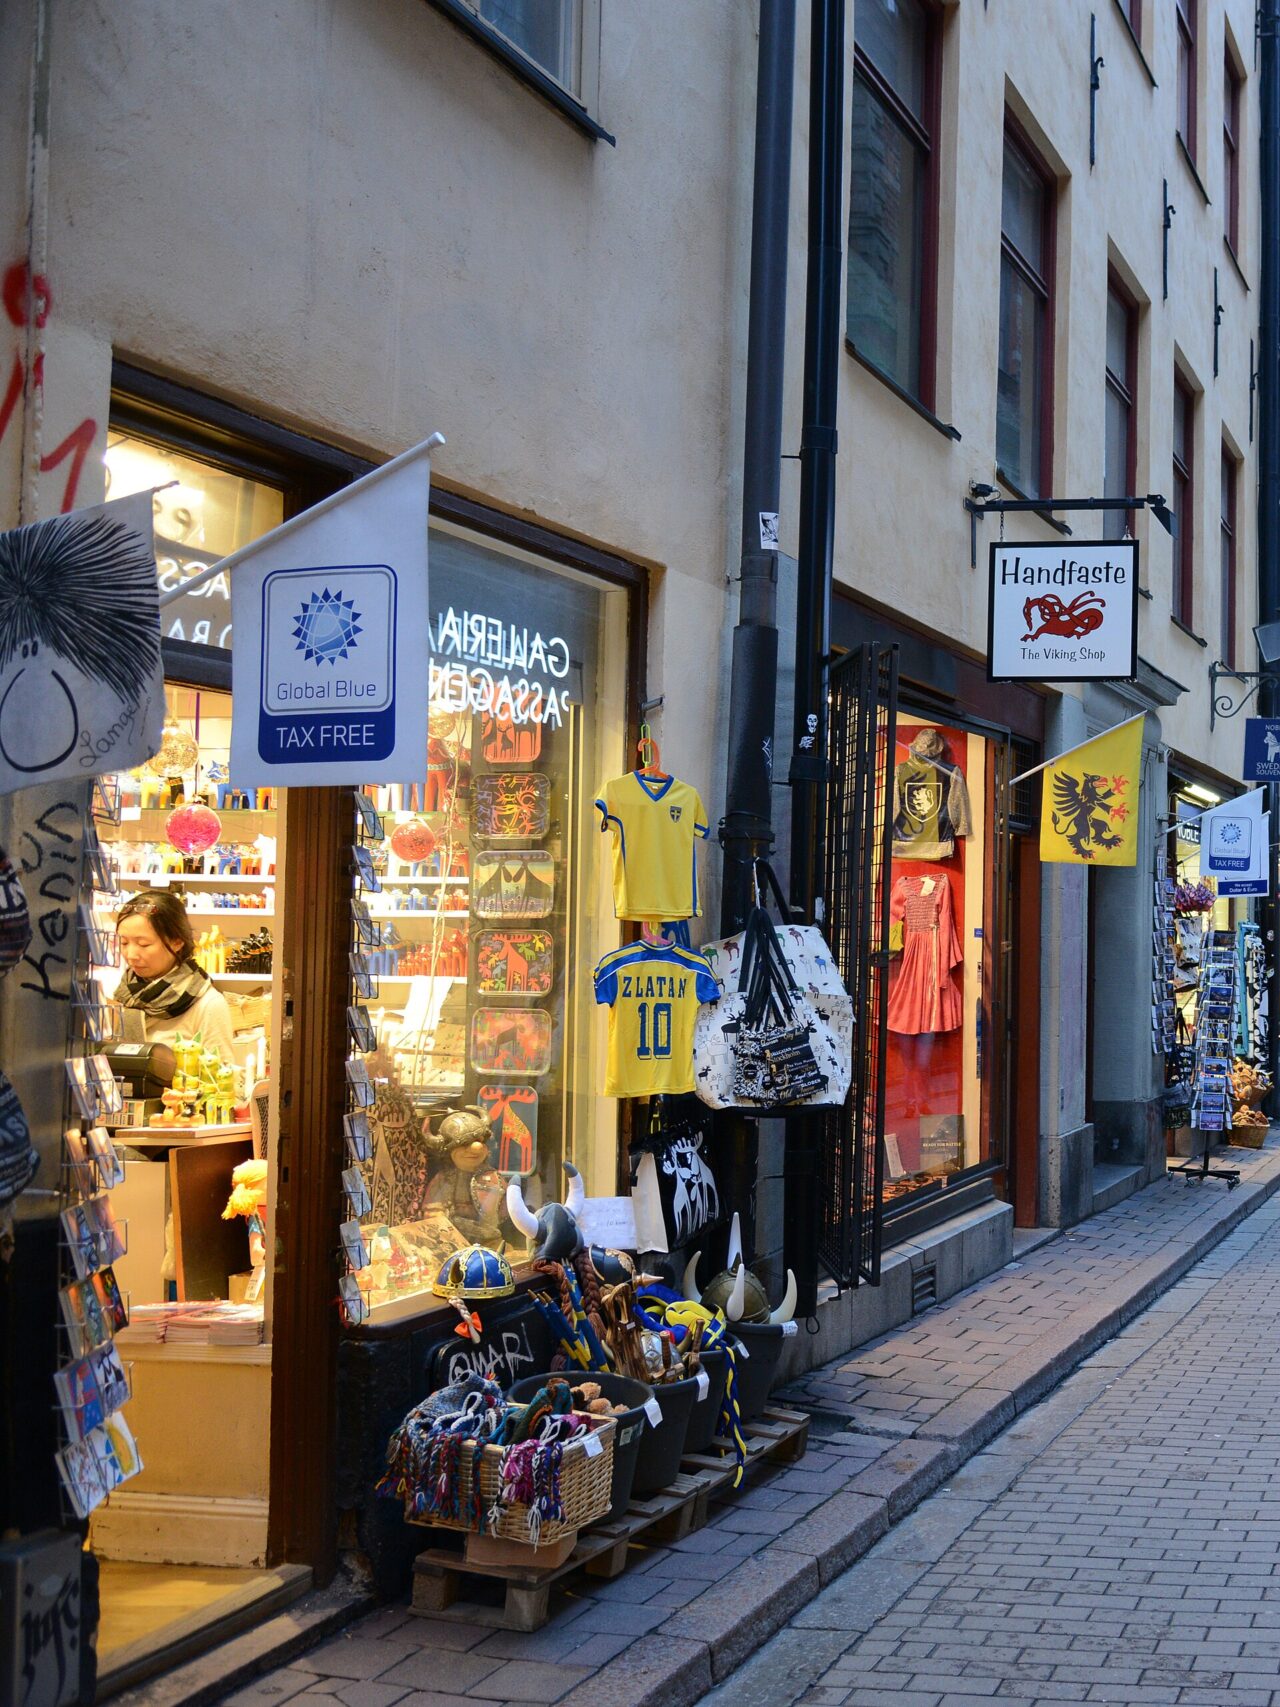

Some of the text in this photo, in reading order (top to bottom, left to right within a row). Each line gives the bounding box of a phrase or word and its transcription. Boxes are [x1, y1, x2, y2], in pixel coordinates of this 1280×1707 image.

[1001, 557, 1126, 586] Handfaste
[1021, 646, 1106, 662] The Viking Shop
[277, 680, 376, 700] Global Blue
[276, 724, 375, 748] TAX FREE
[1214, 859, 1245, 868] TAX FREE
[622, 976, 687, 998] ZLATAN
[637, 1002, 673, 1060] 10
